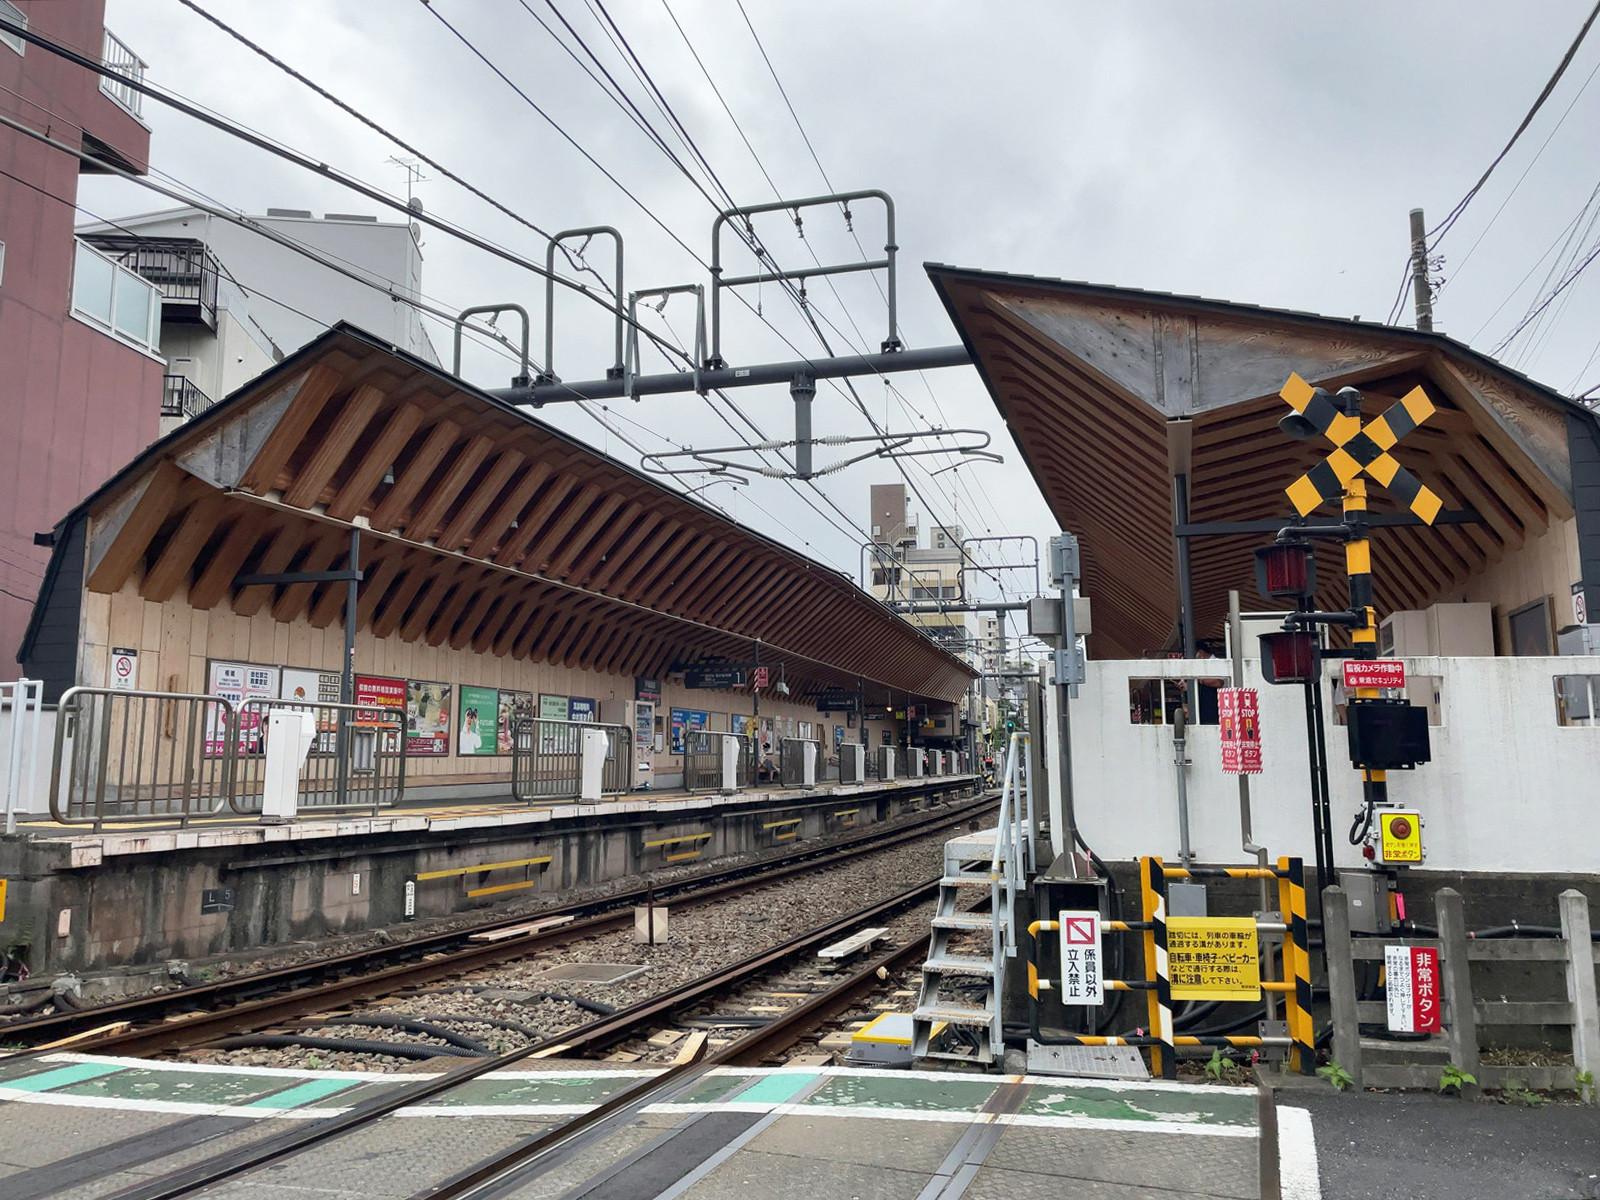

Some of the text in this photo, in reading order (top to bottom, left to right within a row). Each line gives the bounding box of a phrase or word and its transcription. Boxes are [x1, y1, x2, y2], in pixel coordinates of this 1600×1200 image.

[1345, 663, 1402, 674] 監視カメラ作動中
[735, 672, 740, 684] 1
[1358, 676, 1402, 685] 東急セキュリティ
[1222, 708, 1233, 718] STOP
[1241, 708, 1256, 718] STOP
[1244, 749, 1258, 758] ボタン
[1385, 850, 1420, 859] 非常ボタン
[209, 889, 231, 903] L 5
[1067, 948, 1081, 998] 立入禁止
[1084, 948, 1098, 998] 係員以外
[1416, 953, 1434, 1028] 非常ボタン
